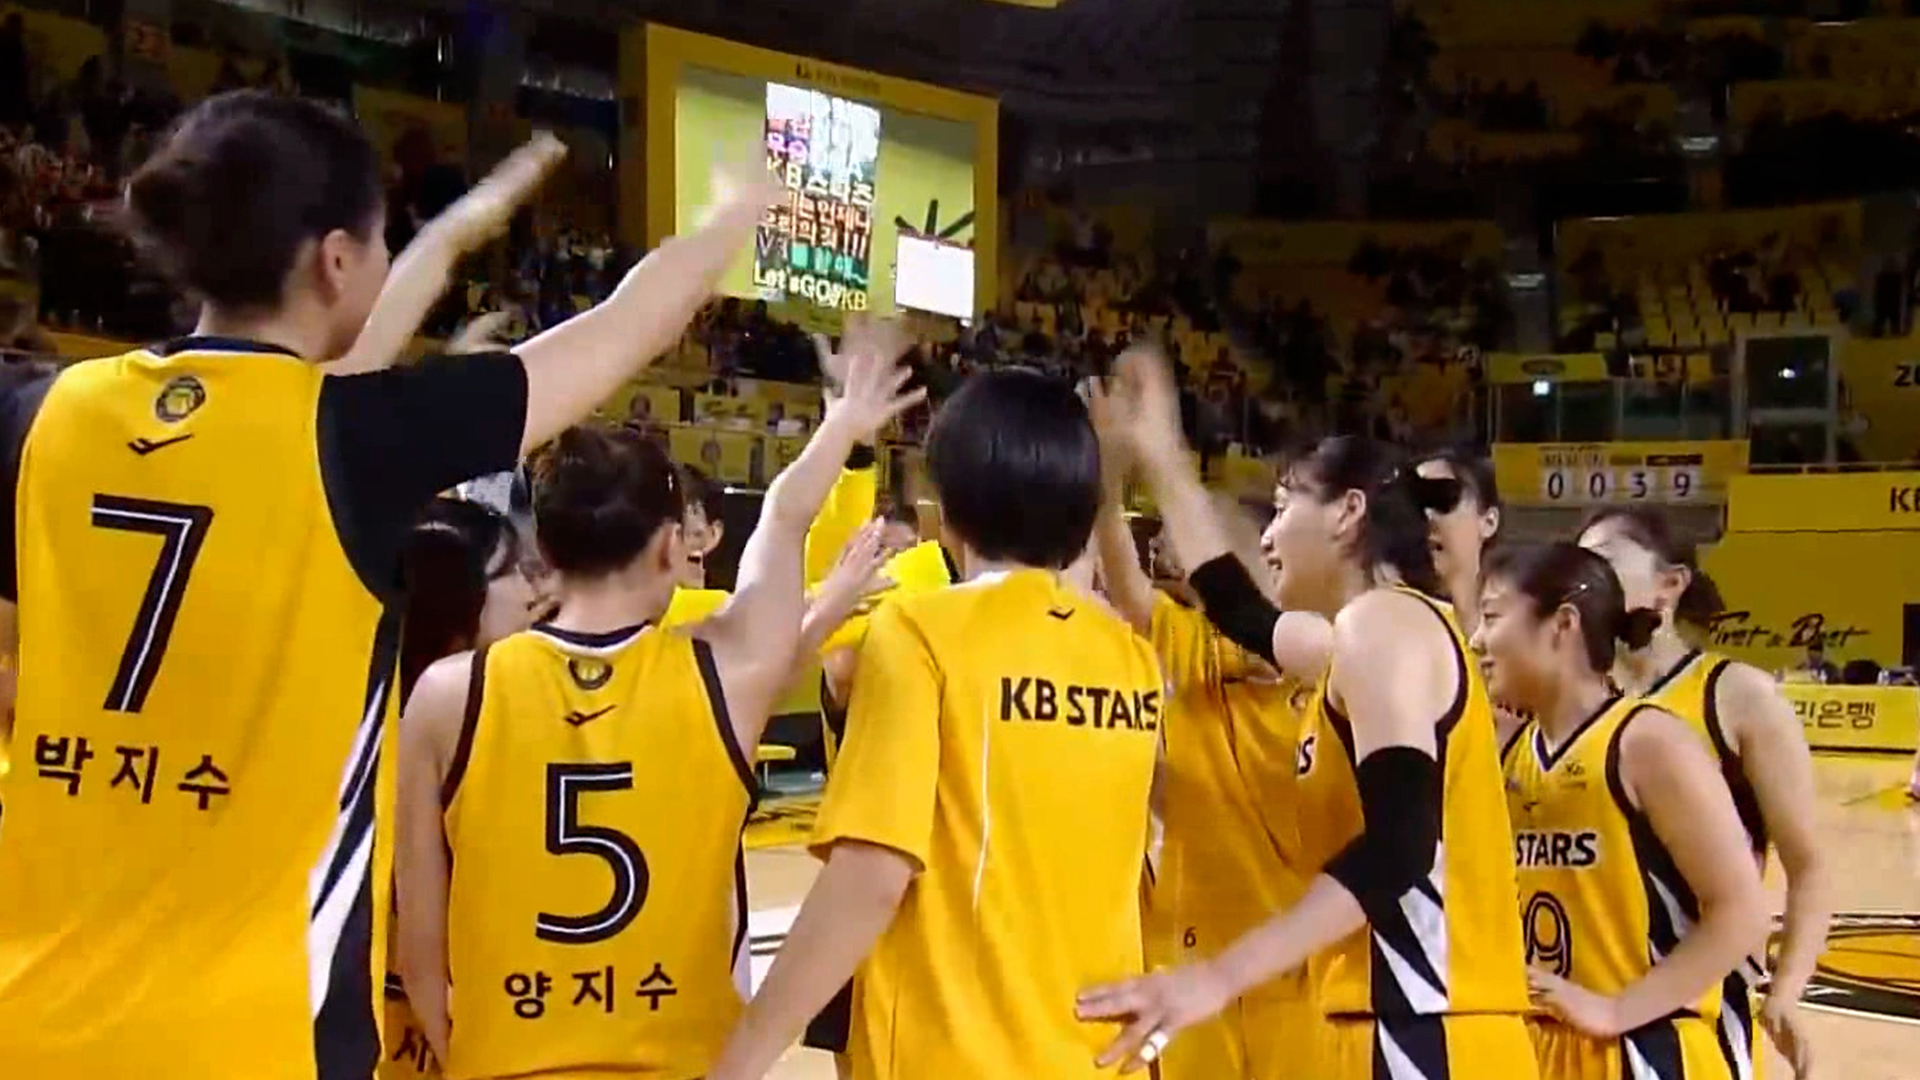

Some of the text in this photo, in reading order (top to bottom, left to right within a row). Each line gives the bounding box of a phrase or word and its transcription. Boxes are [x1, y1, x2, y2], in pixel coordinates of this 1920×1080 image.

[91, 494, 214, 713] 7
[1000, 677, 1058, 721] KB
[535, 762, 650, 944] 5
[1516, 832, 1597, 868] STARS
[1183, 926, 1197, 949] 6
[504, 963, 678, 1019] 양지수
